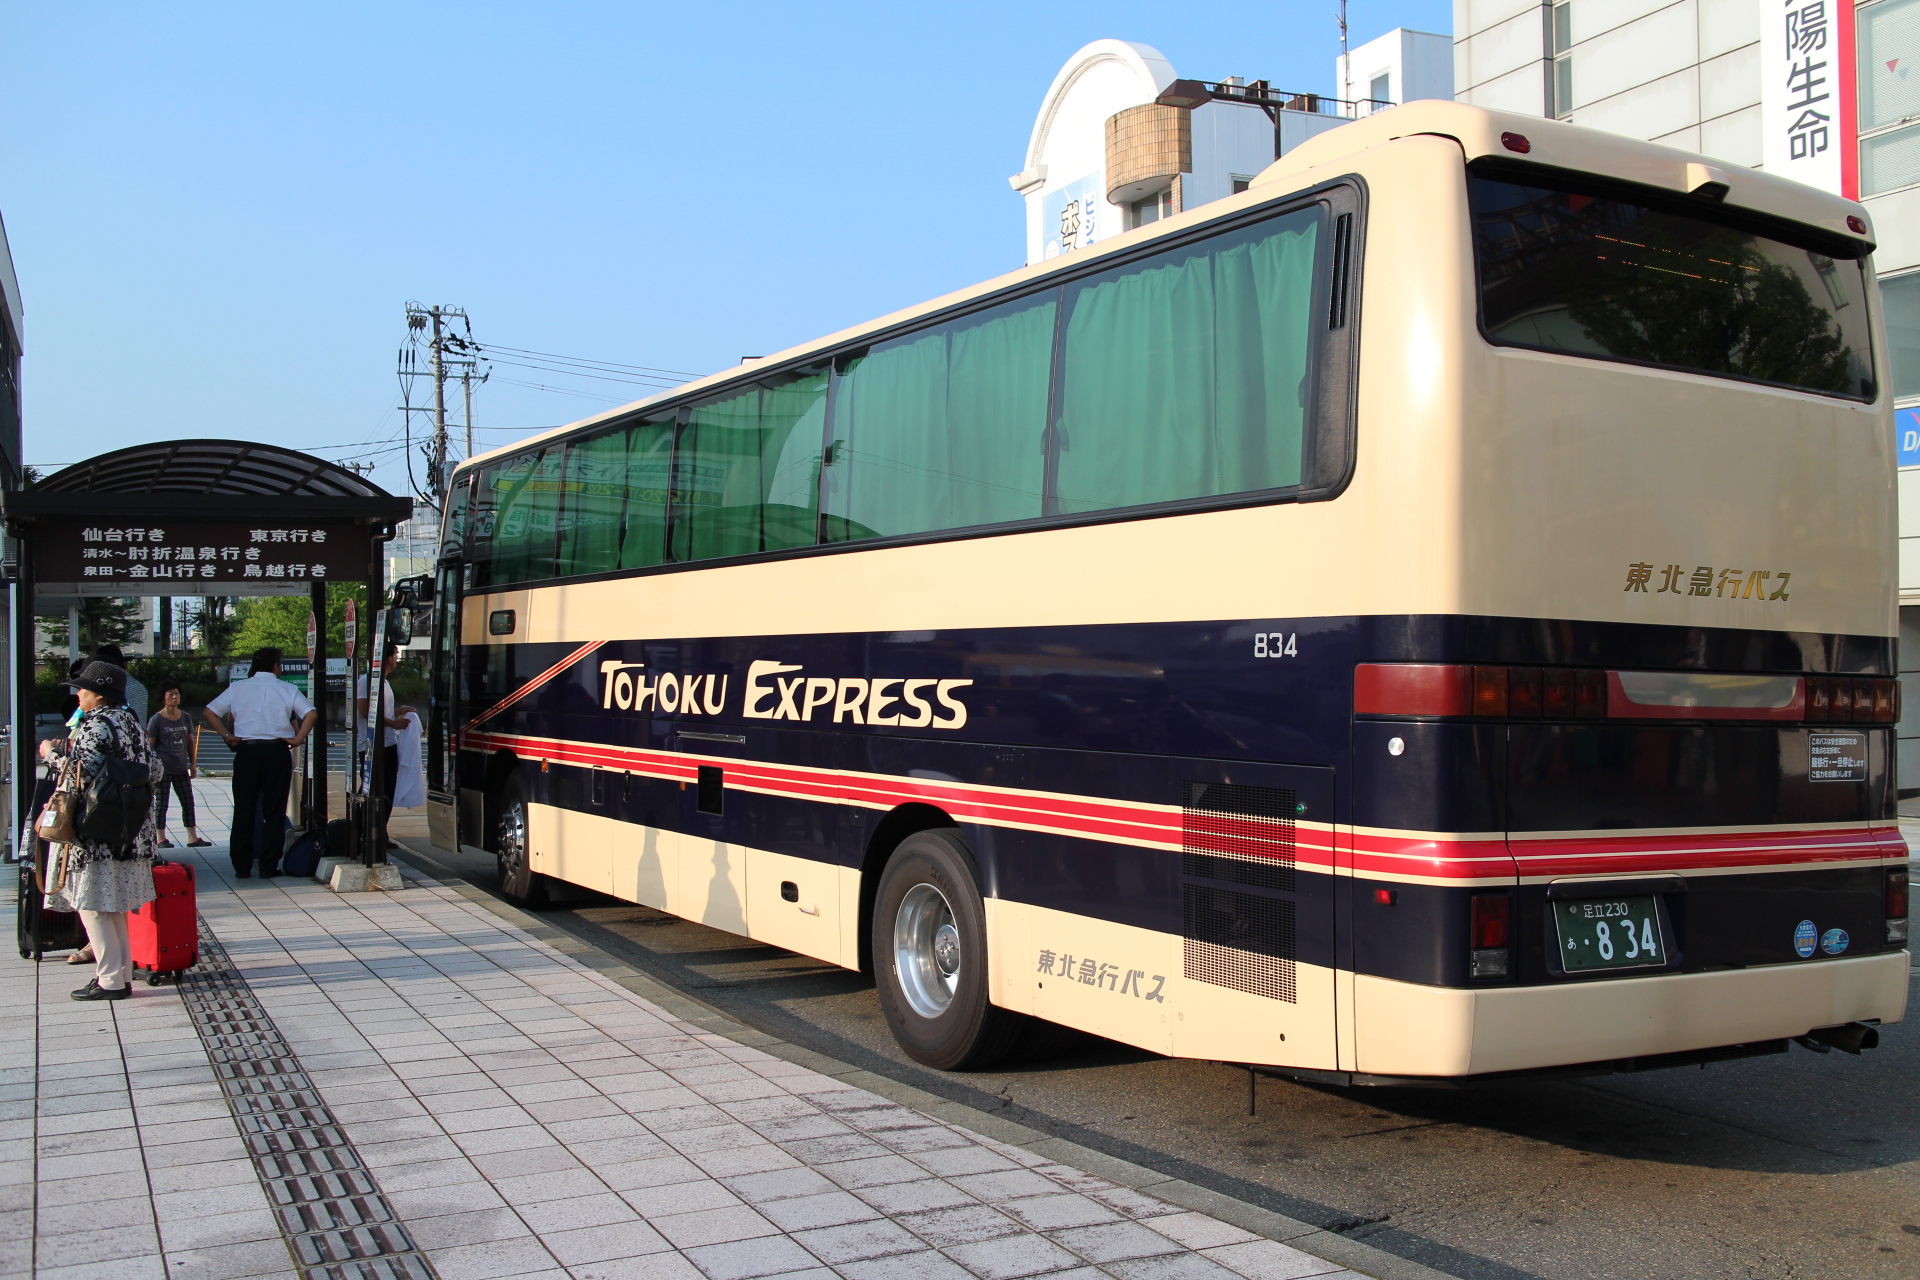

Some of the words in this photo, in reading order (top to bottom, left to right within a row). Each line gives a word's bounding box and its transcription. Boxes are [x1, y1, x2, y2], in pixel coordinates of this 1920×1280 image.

[1785, 0, 1830, 160] 陽生命
[81, 527, 166, 542] 仙台行き
[249, 529, 328, 543] 東京行き
[1624, 562, 1791, 602] 東北急行バス
[1254, 632, 1298, 658] 834
[600, 660, 728, 716] TOHOKU
[742, 659, 974, 730] EXPRESS
[1037, 949, 1166, 1004] 東北急行バス
